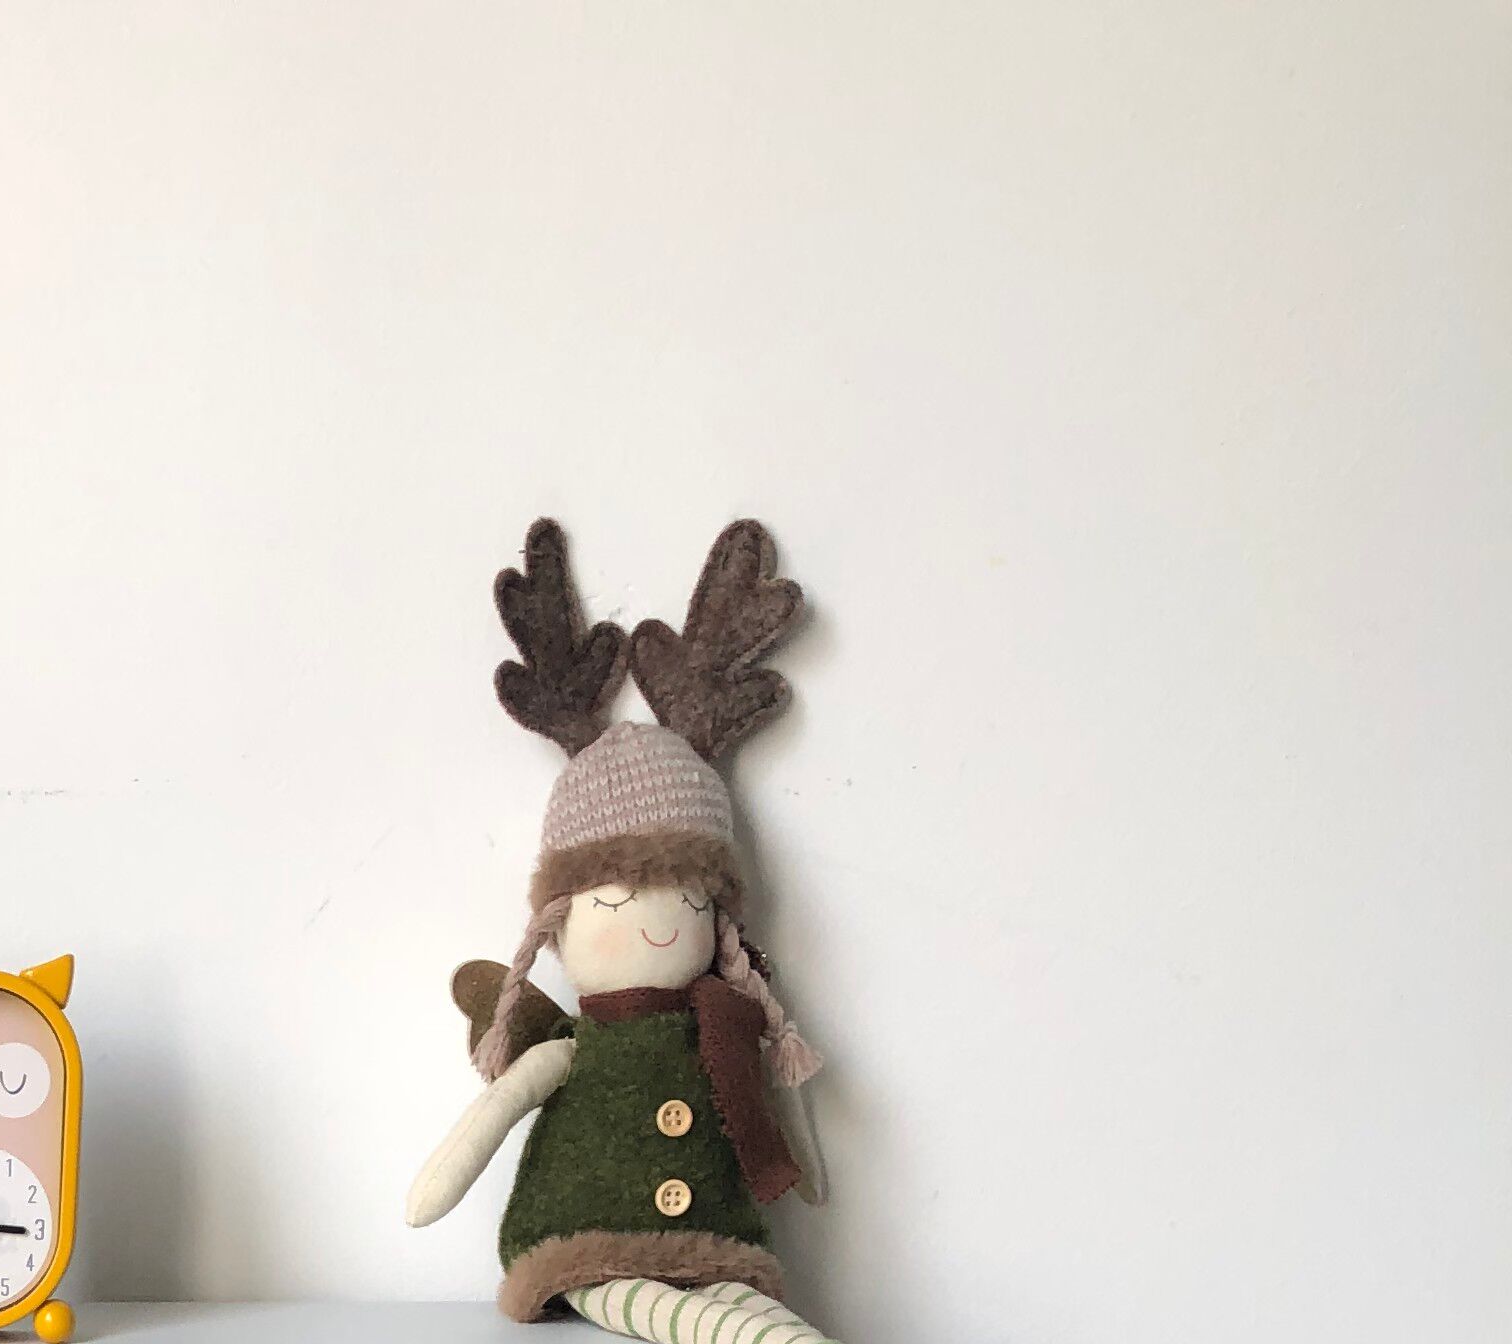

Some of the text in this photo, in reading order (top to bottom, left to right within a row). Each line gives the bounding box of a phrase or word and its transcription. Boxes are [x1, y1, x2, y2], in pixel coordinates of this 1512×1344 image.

[6, 1159, 12, 1177] 1
[27, 1185, 38, 1203] 2
[34, 1219, 45, 1241] 3
[26, 1253, 35, 1272] 4
[0, 1278, 10, 1296] 5
